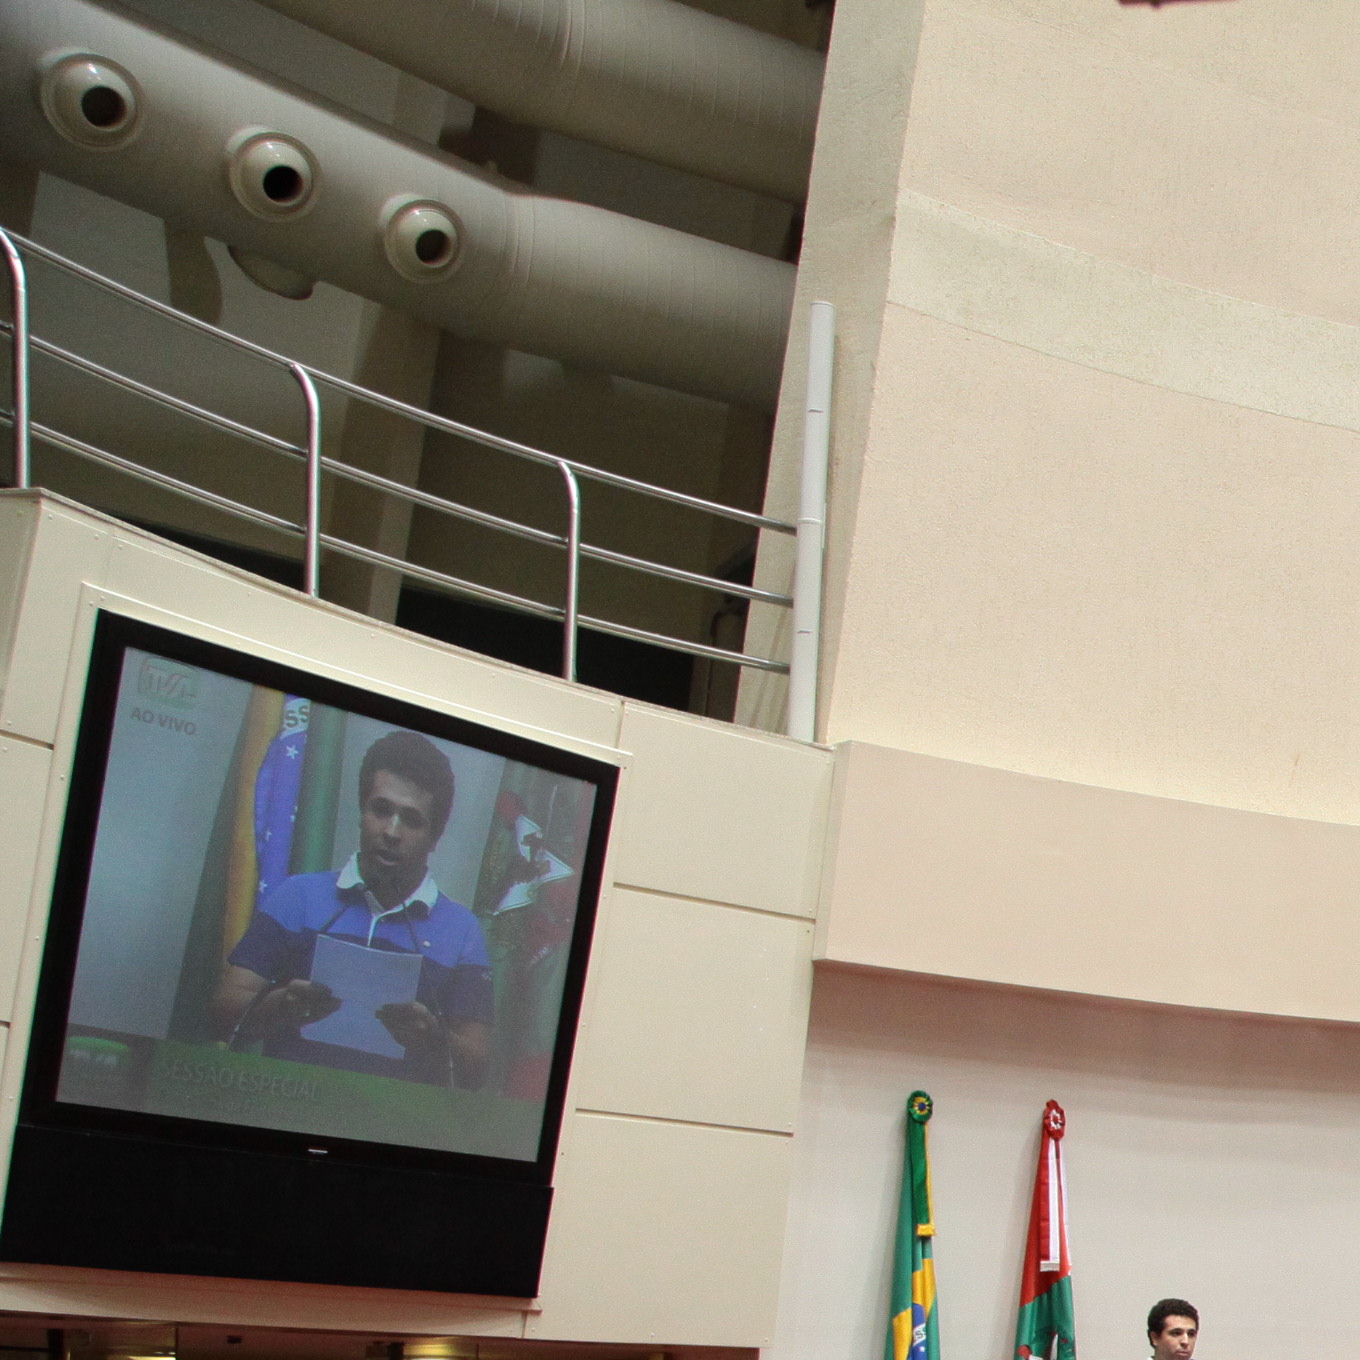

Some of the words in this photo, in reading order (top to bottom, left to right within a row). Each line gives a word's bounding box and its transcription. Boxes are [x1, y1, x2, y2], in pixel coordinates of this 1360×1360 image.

[130, 707, 154, 723] AO
[159, 714, 197, 736] VIVO
[238, 1070, 320, 1102] ESPECIAL
